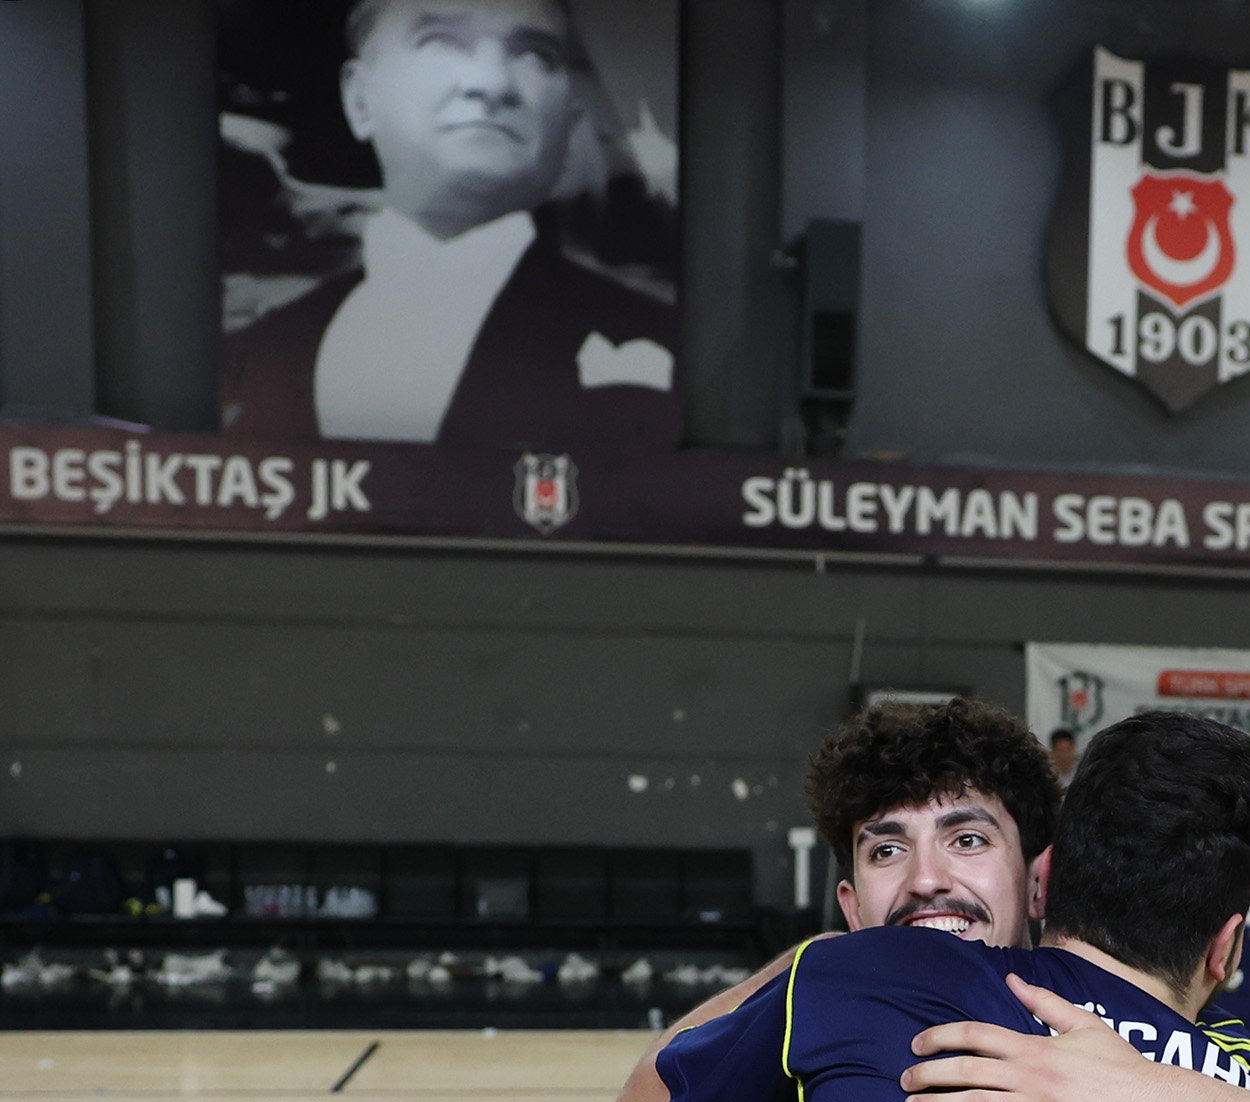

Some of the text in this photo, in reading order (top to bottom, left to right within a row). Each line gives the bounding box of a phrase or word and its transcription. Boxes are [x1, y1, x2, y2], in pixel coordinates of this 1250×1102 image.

[9, 440, 372, 521] BEŞİKTAŞ JK
[741, 467, 1038, 540] SÜLEYMAN
[1052, 493, 1191, 548] SEBA
